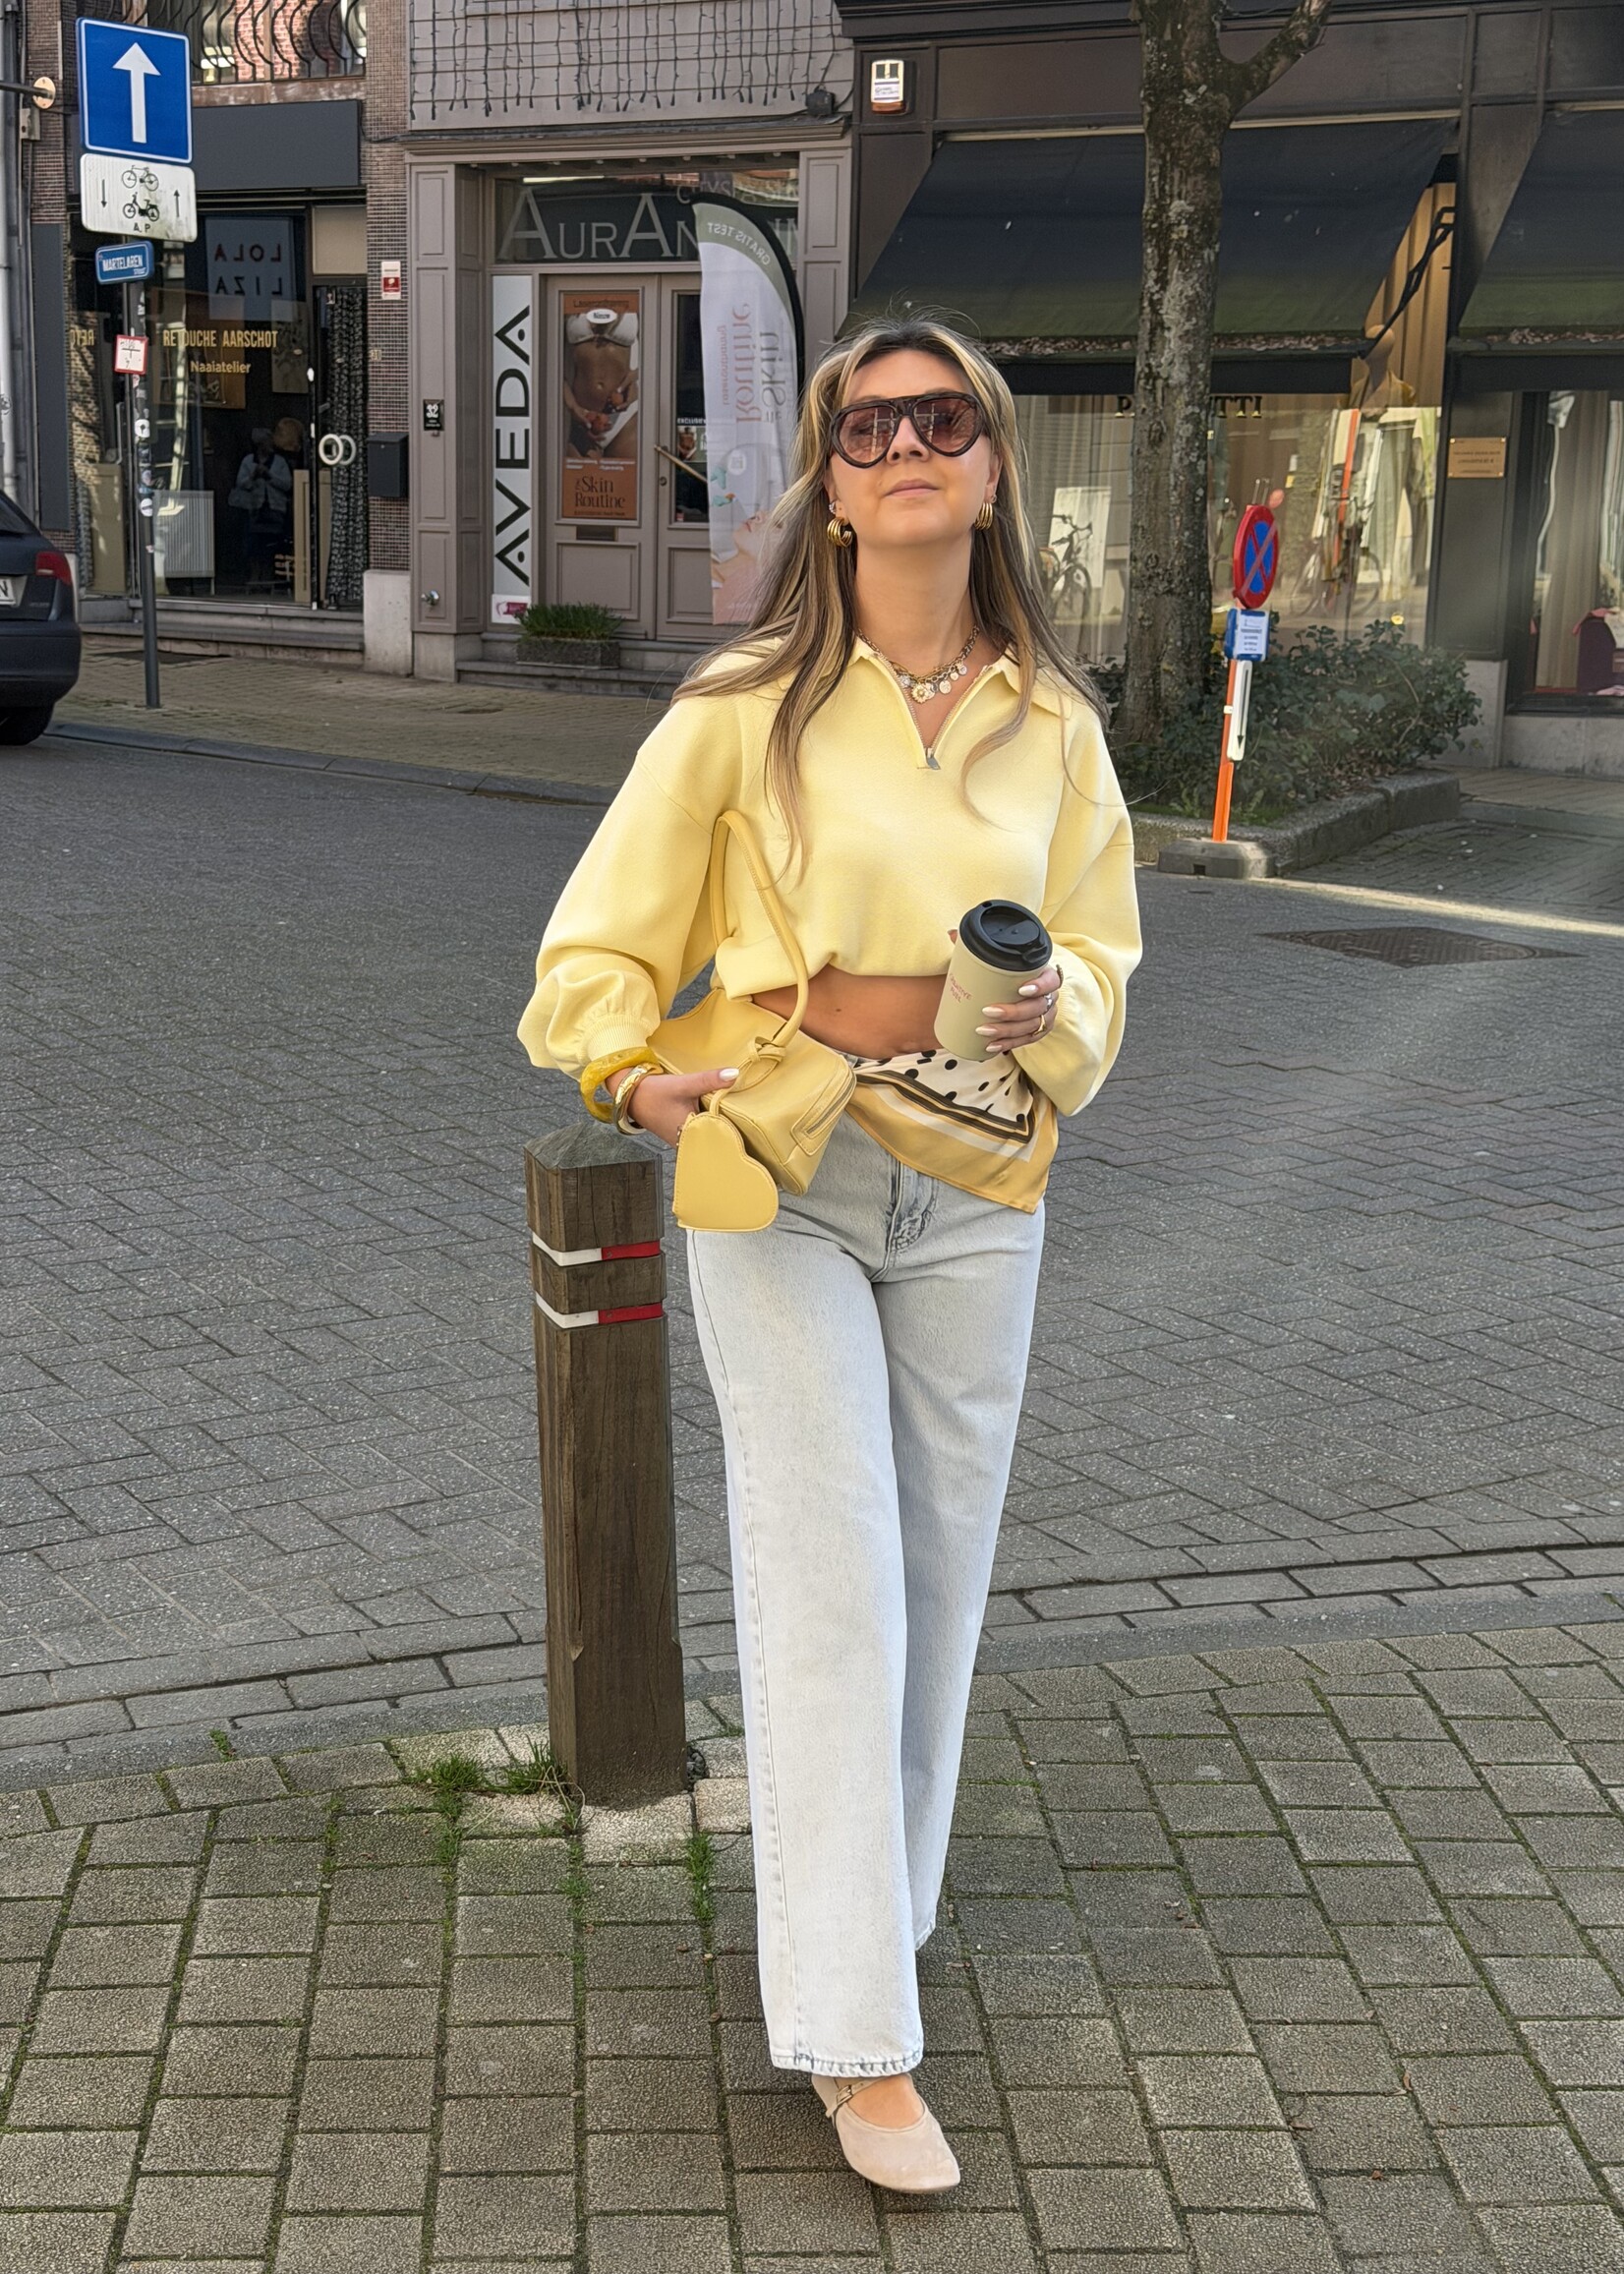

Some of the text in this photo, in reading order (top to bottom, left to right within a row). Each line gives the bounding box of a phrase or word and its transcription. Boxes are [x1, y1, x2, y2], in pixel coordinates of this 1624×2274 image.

[163, 329, 278, 348] RETOUCHE AARSCHOT
[190, 360, 252, 374] Naaiatelier
[426, 403, 438, 419] 32
[494, 305, 531, 587] AVEDA
[582, 476, 613, 493] Skin
[575, 492, 625, 508] Routine
